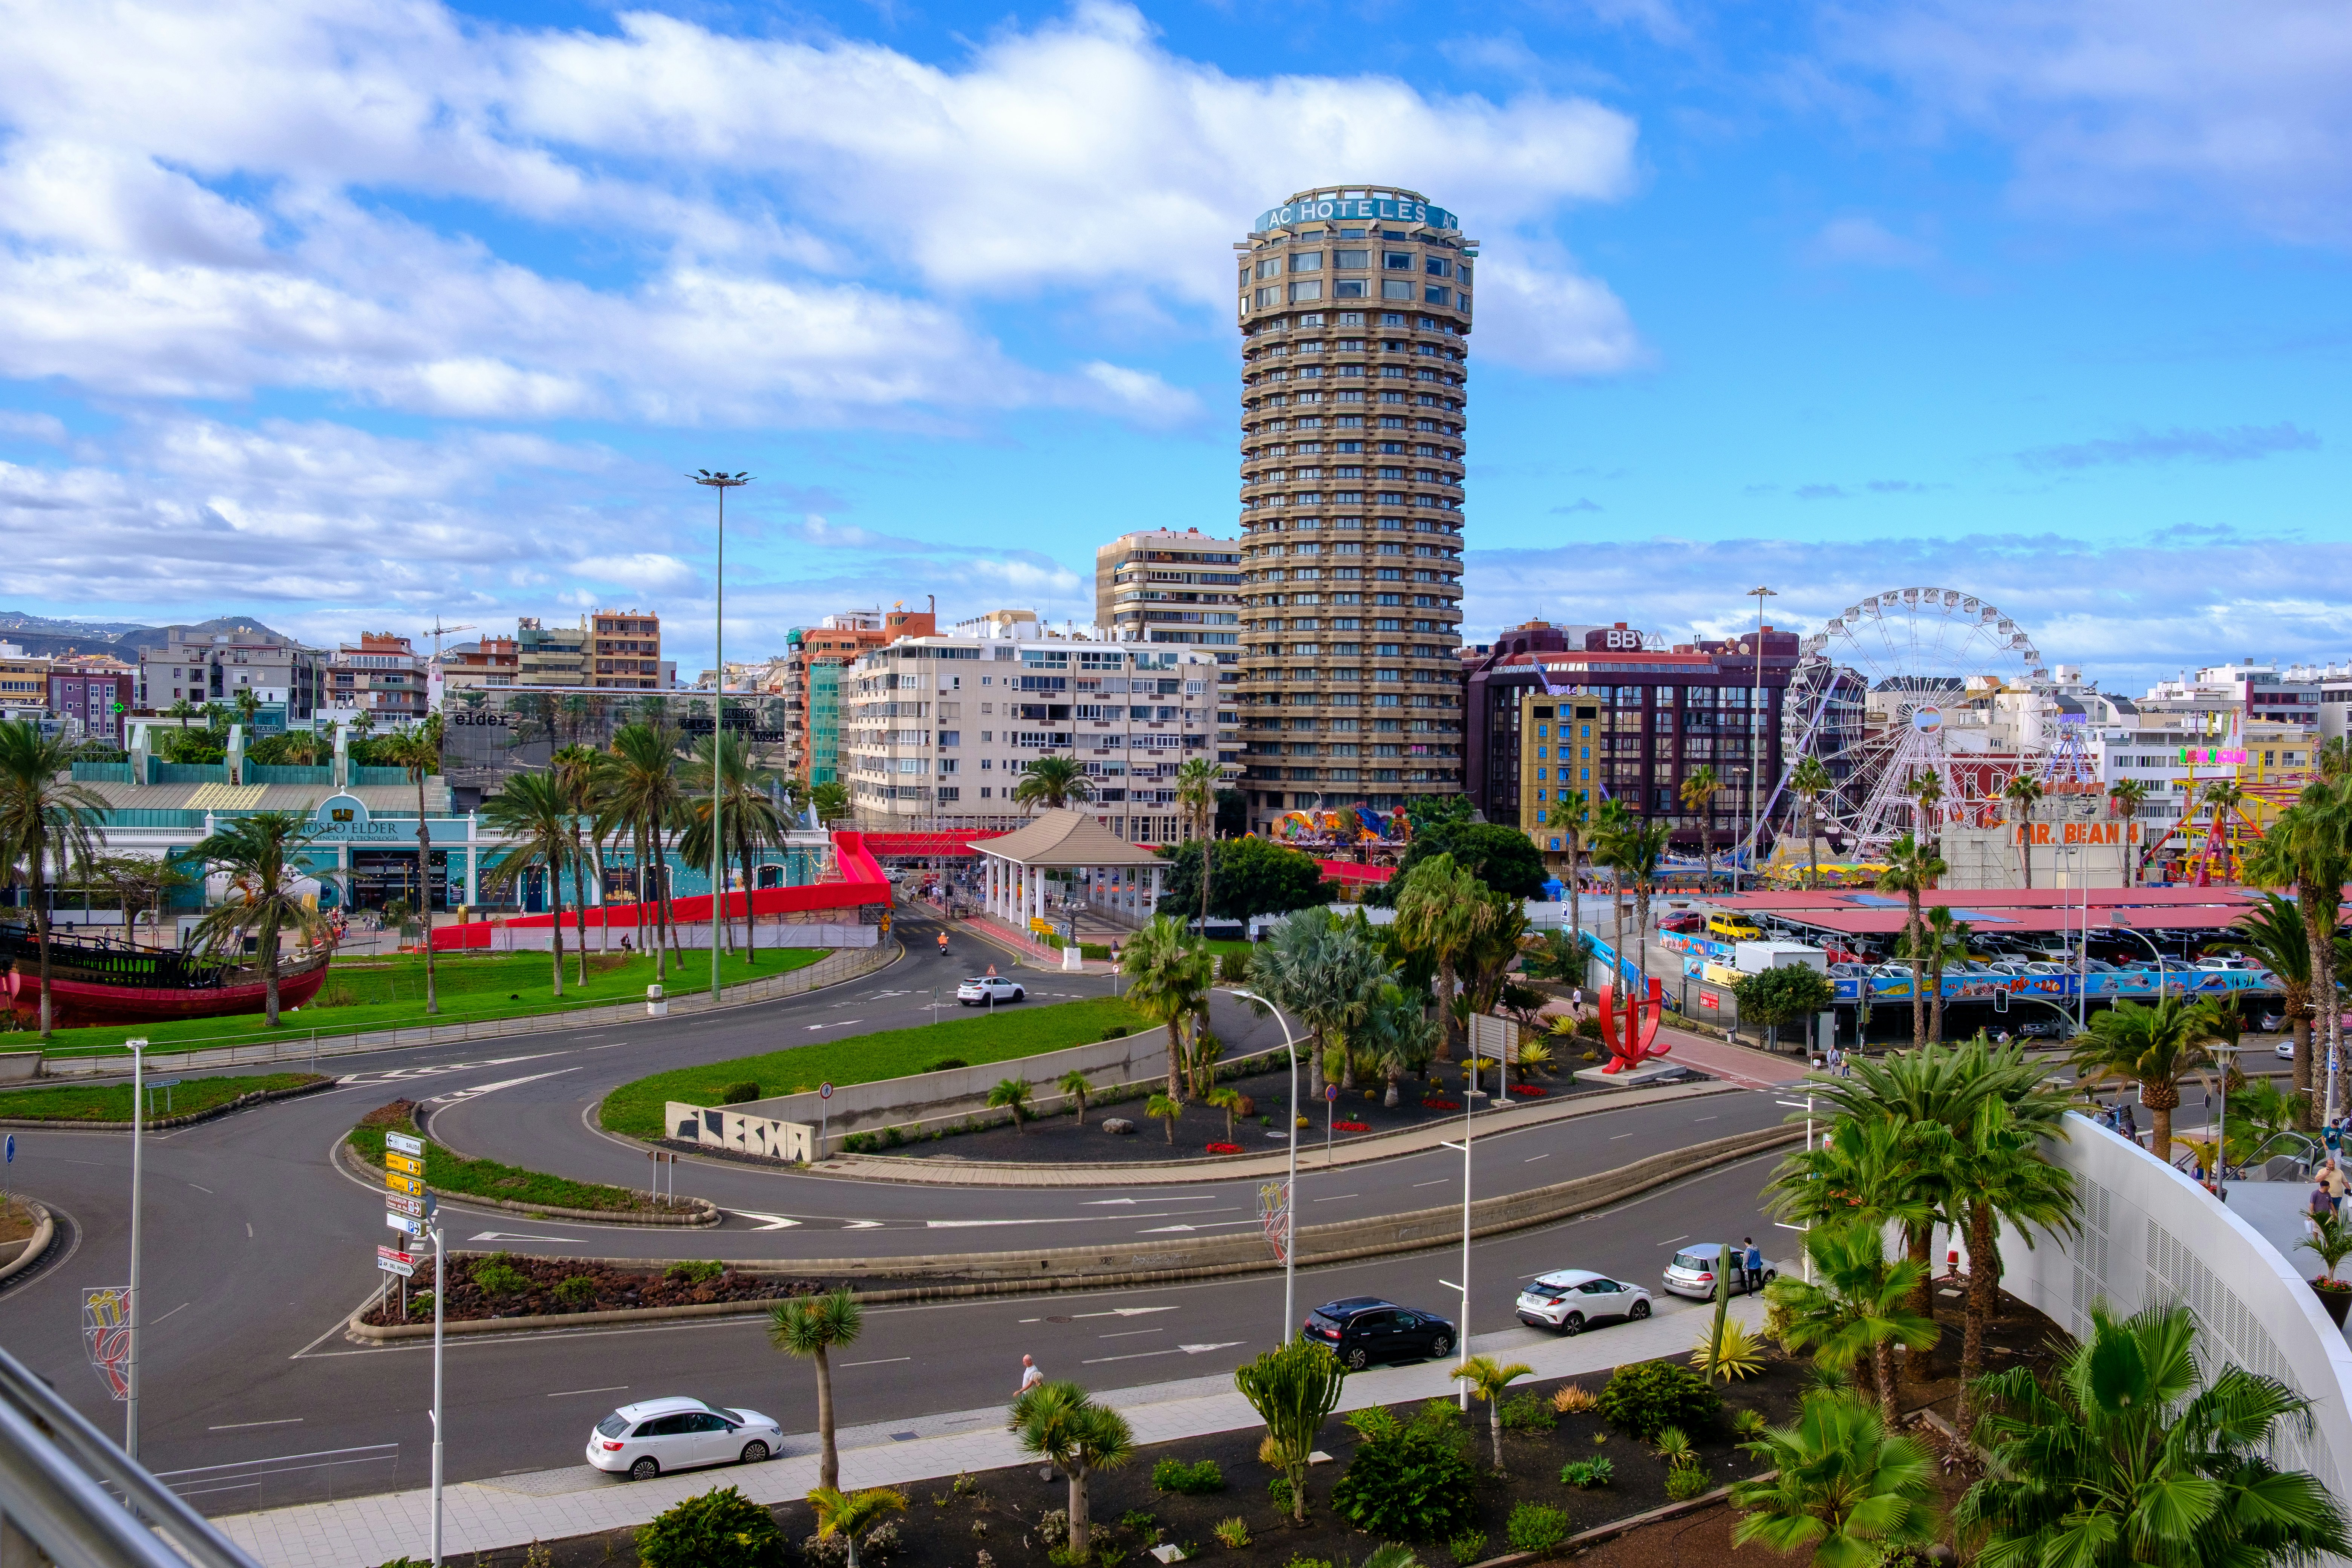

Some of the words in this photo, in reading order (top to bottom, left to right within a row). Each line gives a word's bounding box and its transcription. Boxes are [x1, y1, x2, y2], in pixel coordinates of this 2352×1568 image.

[1269, 208, 1291, 227] AC
[1300, 200, 1426, 222] HOTELES
[1442, 215, 1456, 231] AC
[1607, 629, 1666, 648] BBVA
[723, 709, 755, 718] MUSEO
[679, 720, 691, 728] DE
[695, 720, 707, 729] LA
[711, 720, 754, 729] CENCIA
[2056, 713, 2087, 726] SUPER
[351, 822, 398, 834] ELDER
[2064, 823, 2119, 844] BEAN
[2128, 823, 2138, 844] 4
[1562, 902, 1567, 916] P
[406, 1142, 420, 1151] SALIDA
[409, 1182, 414, 1191] P
[388, 1194, 407, 1205] AQUARIUM
[409, 1222, 414, 1231] P
